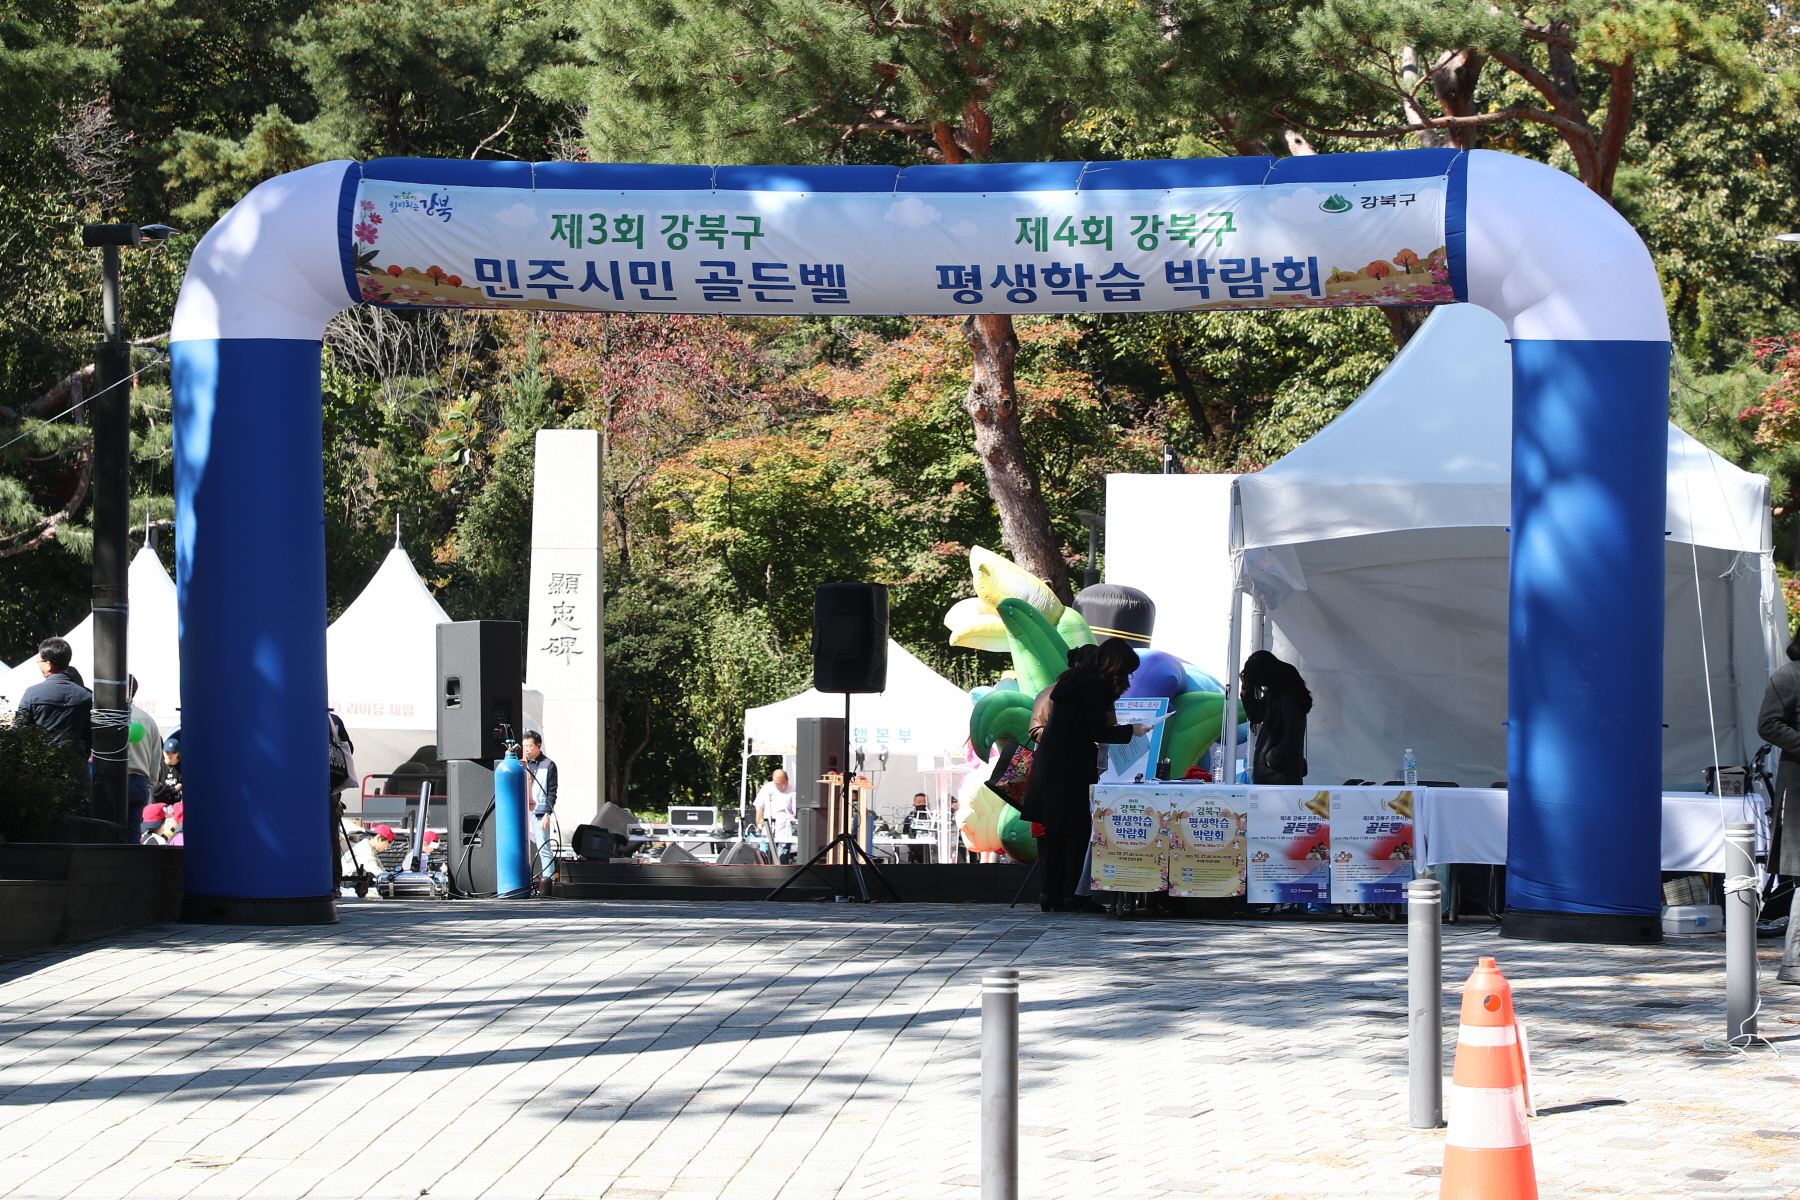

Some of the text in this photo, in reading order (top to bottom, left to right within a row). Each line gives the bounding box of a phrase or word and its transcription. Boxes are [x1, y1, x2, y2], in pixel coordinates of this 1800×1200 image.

[419, 192, 453, 223] 강북
[1360, 193, 1416, 209] 강북구
[550, 213, 766, 251] 제3회 강북구
[1014, 211, 1238, 252] 제4회 강북구
[473, 257, 852, 304] 민주시민 골든벨
[935, 256, 1324, 304] 평생학습 박람회
[540, 572, 584, 666] 顯忠碑
[346, 702, 384, 716] 라이딩
[389, 703, 414, 717] 체험
[1127, 701, 1144, 709] 만족도
[1147, 701, 1158, 709] 조사
[1120, 804, 1146, 813] 강북구
[1196, 806, 1222, 816] 강북구
[1112, 815, 1153, 828] 평생학습
[1188, 817, 1230, 829] 평생학습
[1365, 822, 1405, 834] 골든벨
[1116, 828, 1147, 840] 박람회
[1282, 822, 1321, 835] 골든벨
[1193, 830, 1224, 841] 박람회
